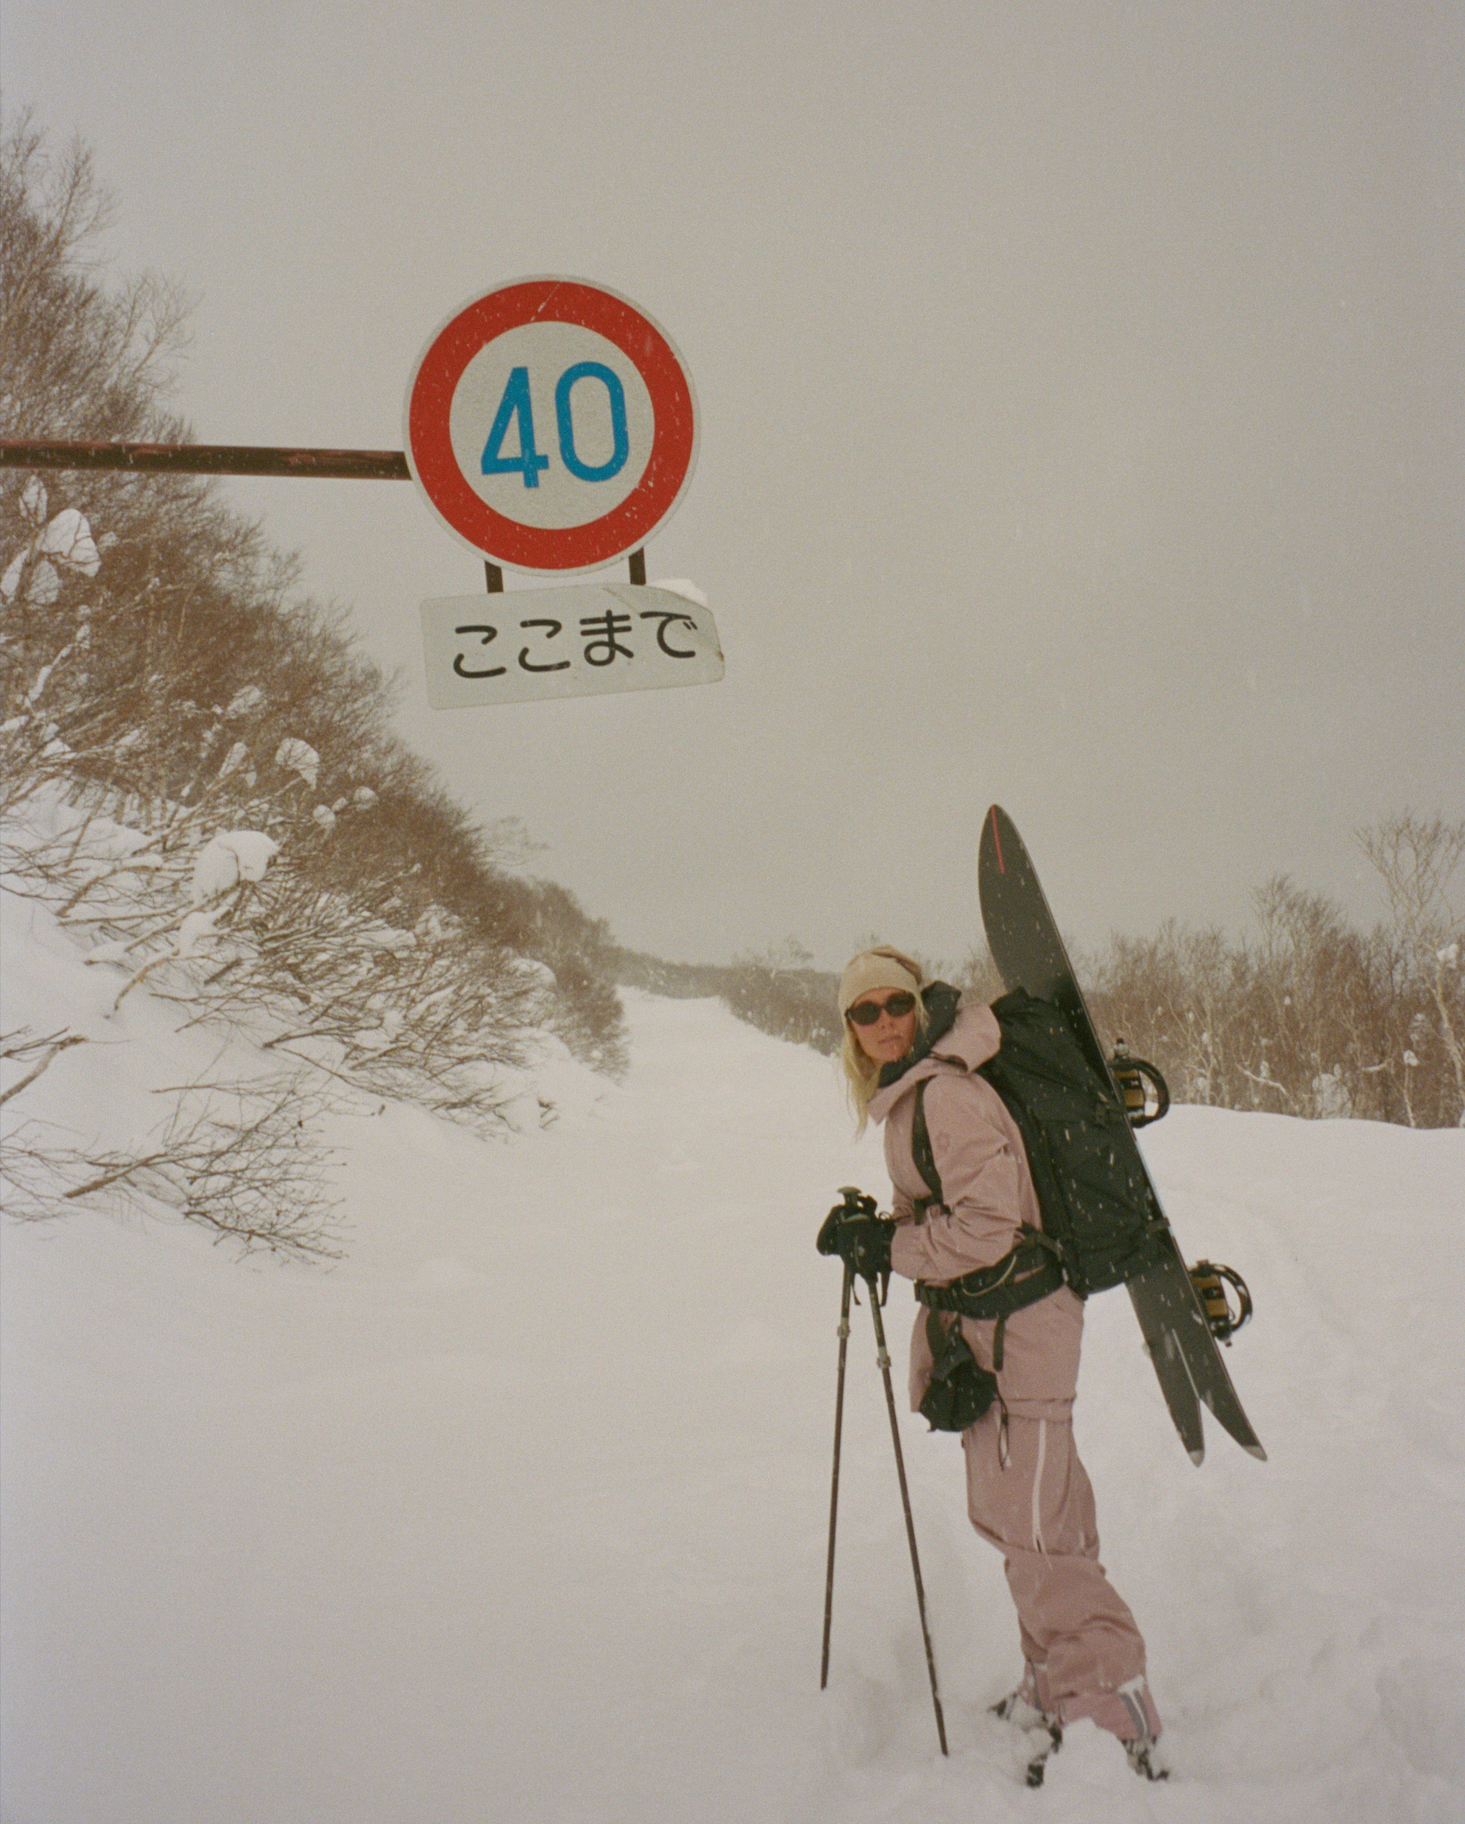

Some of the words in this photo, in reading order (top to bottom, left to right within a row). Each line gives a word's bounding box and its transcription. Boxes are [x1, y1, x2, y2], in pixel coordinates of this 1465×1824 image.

[481, 361, 629, 488] 40
[453, 609, 698, 679] ここまで
